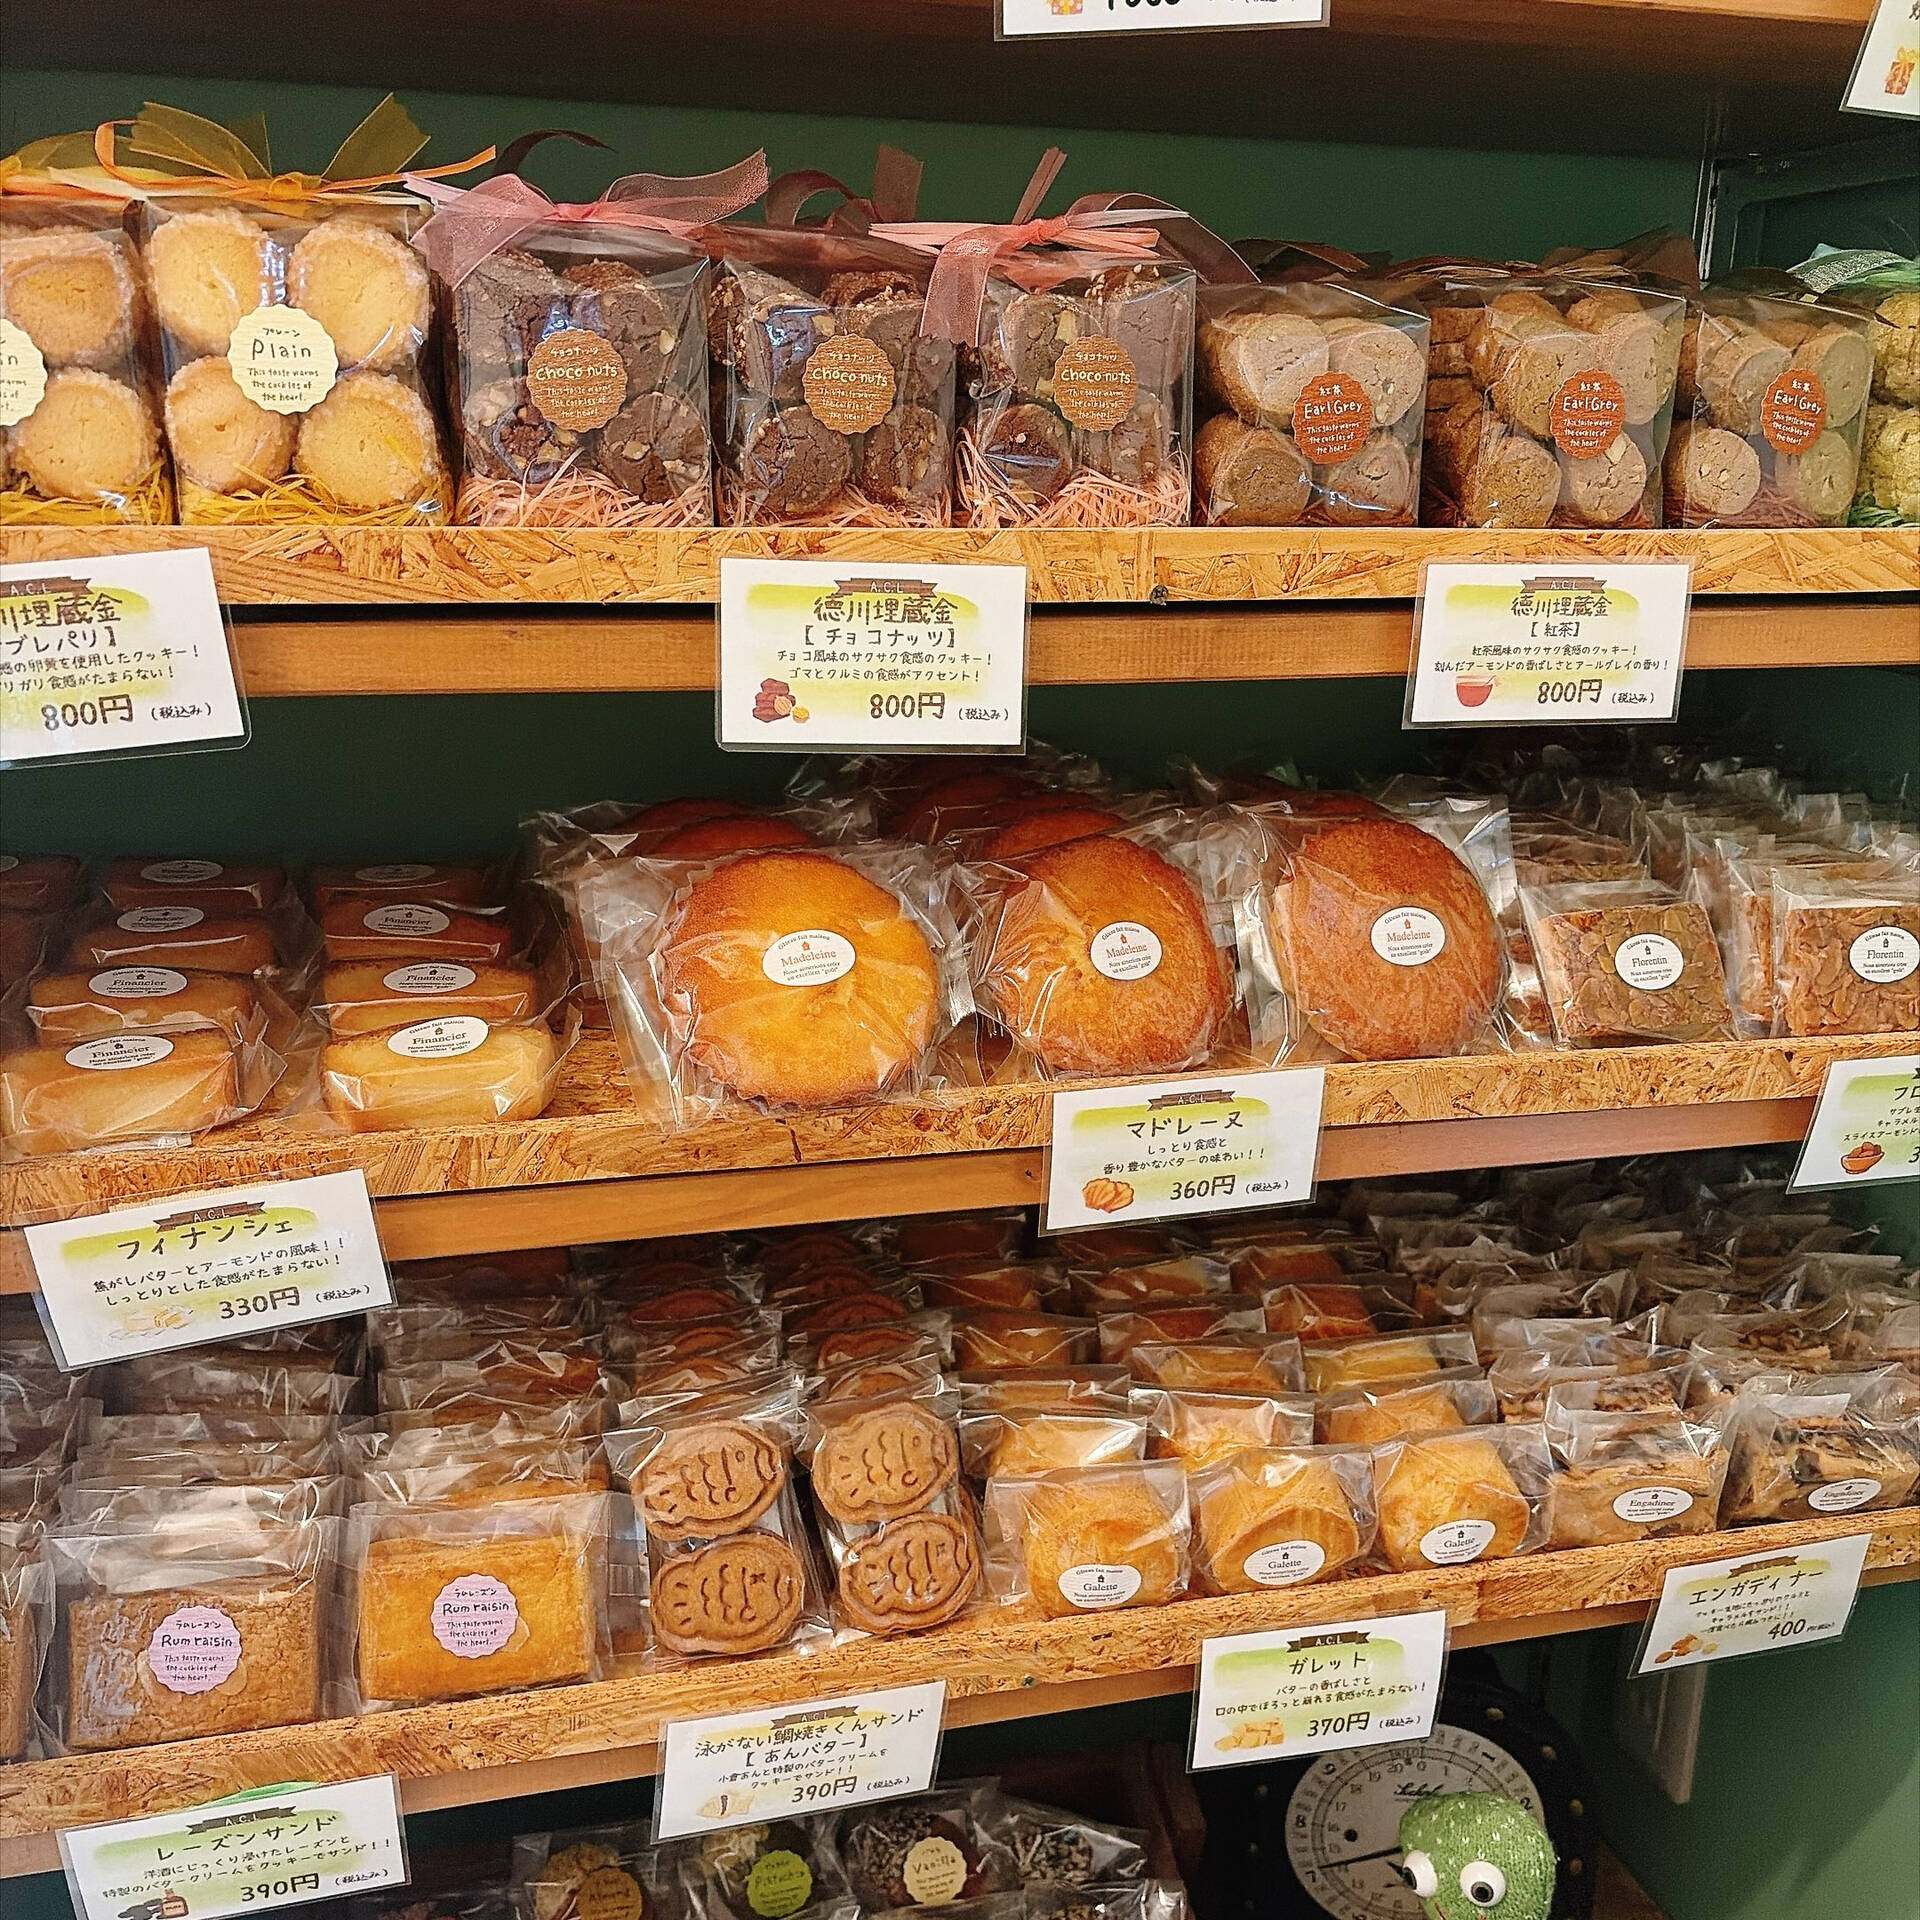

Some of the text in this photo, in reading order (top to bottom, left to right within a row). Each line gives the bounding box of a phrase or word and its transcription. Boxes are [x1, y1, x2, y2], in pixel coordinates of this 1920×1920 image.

[252, 338, 311, 361] Plain
[536, 363, 618, 381] Choco nuts
[812, 367, 888, 387] Choco nuts
[1060, 368, 1131, 384] Choco nuts
[1304, 399, 1363, 420] Earl Grey
[1562, 396, 1619, 412] Earl Grey
[1774, 389, 1822, 415] Earl Grey
[813, 594, 958, 625] 徳川埋蔵金
[1510, 594, 1612, 618] 徳川埋蔵金
[805, 625, 955, 648] 【チョコナッツ】
[1530, 621, 1580, 638] 【紅茶】
[0, 625, 117, 656] ブレパリ】
[1471, 643, 1638, 657] 紅茶風味のサクサク食感のクッキー！
[777, 650, 992, 666] チョコ風味のサクサク食感のクッキー！
[1434, 659, 1668, 673] 刻んだアーモンドの香ばしさとアールグレイの香り！
[0, 666, 174, 693] リガリ食感がたまらない！
[789, 668, 980, 682] ゴマとクルミの食感がアクセント！
[1537, 678, 1655, 705] 800円 （税込み）
[41, 693, 212, 732] 800円 （税込み）
[870, 692, 1009, 721] 800円 （税込み）
[1386, 928, 1431, 942] Madeleine
[780, 949, 838, 967] Madeleine
[1106, 943, 1148, 959] Madeleine
[1867, 949, 1904, 960] Florentin
[1631, 957, 1668, 968] Florentin
[112, 979, 166, 987] Financier
[406, 974, 457, 983] Financier
[412, 1032, 467, 1045] Financier
[92, 1046, 150, 1058] Financier
[1127, 1111, 1244, 1139] マドレーヌ
[1843, 1128, 1920, 1141] スライスアーモンド
[1147, 1137, 1227, 1156] しっとり食感と
[1103, 1148, 1266, 1175] 香り豊かなバターの味わい！！
[1170, 1175, 1290, 1201] 360円 （税込み）
[117, 1217, 294, 1261] フィナンシェ
[93, 1237, 346, 1294] 焦がしバターとアーモンドの風味！！
[106, 1253, 341, 1307] しっとりとした食感がたまらない！
[219, 1284, 371, 1321] 330円 （税込み）
[1444, 1537, 1476, 1548] Galette
[1268, 1560, 1302, 1569] Galette
[1083, 1583, 1118, 1592] Galette
[1689, 1568, 1824, 1605] エンガディナー
[442, 1602, 509, 1616] Rum raisin
[1768, 1619, 1807, 1640] 400
[161, 1634, 233, 1647] Rum raisin
[1315, 1636, 1342, 1646] A.C.L
[1289, 1651, 1367, 1675] ガレット
[1276, 1676, 1371, 1696] バターの香ばしさと
[1215, 1682, 1427, 1716] 口の中でほろっと崩れる食感がたまらない！
[695, 1708, 924, 1759] 泳がない鯛焼きくんサンド
[1307, 1712, 1421, 1737] 370円 （税込み）
[746, 1733, 867, 1767] 【あんバター】
[718, 1748, 888, 1784] 小倉あんと特製のバタークリームを
[751, 1764, 853, 1790] クッキーでサンド！！
[791, 1775, 910, 1803] 390円 （税込み）
[1295, 1815, 1306, 1829] 8
[157, 1815, 337, 1862] レーズンサンド
[912, 1855, 956, 1875] Vanilla
[241, 1868, 389, 1903] 390円 （税込み）
